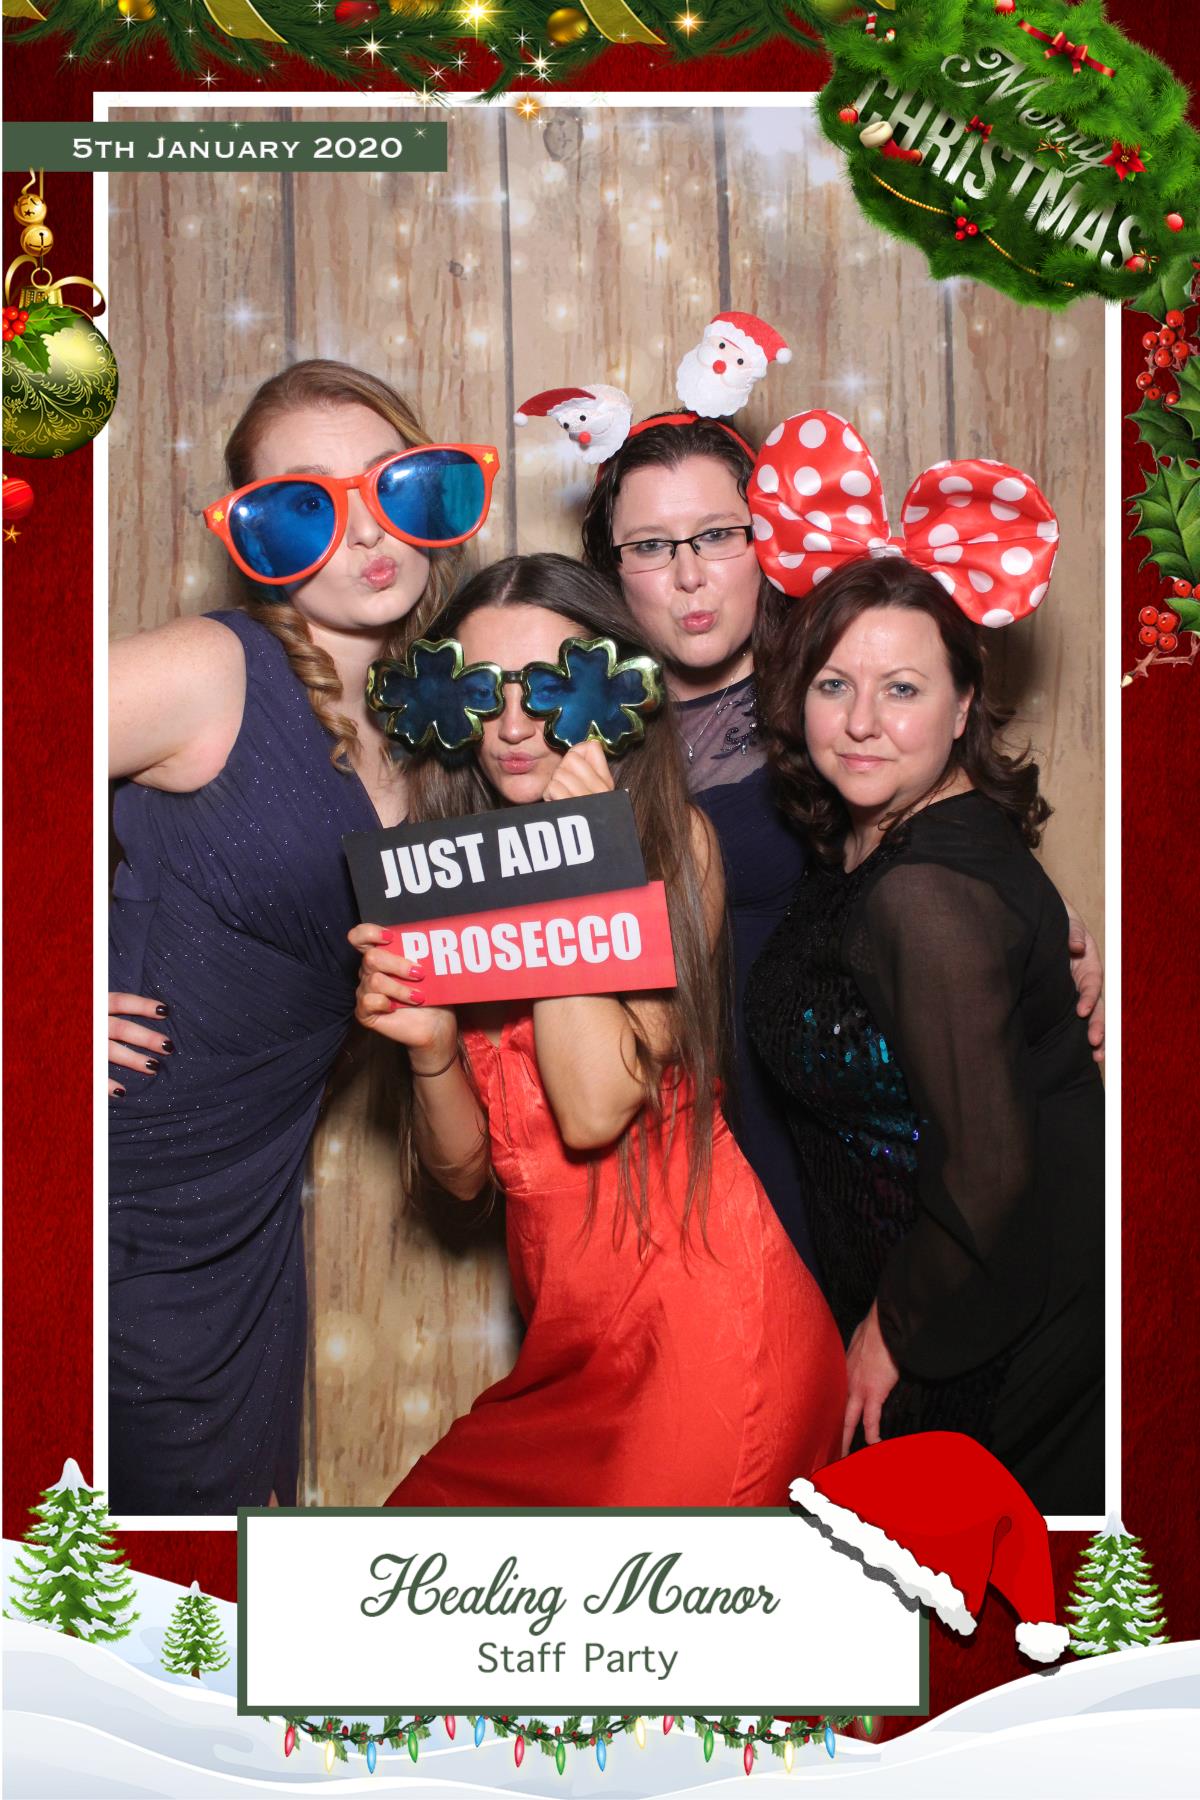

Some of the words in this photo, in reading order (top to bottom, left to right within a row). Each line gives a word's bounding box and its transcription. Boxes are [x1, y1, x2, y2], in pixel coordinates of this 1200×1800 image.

[380, 832, 485, 899] JUST
[497, 814, 595, 879] ADD
[401, 912, 642, 977] PROSECCO
